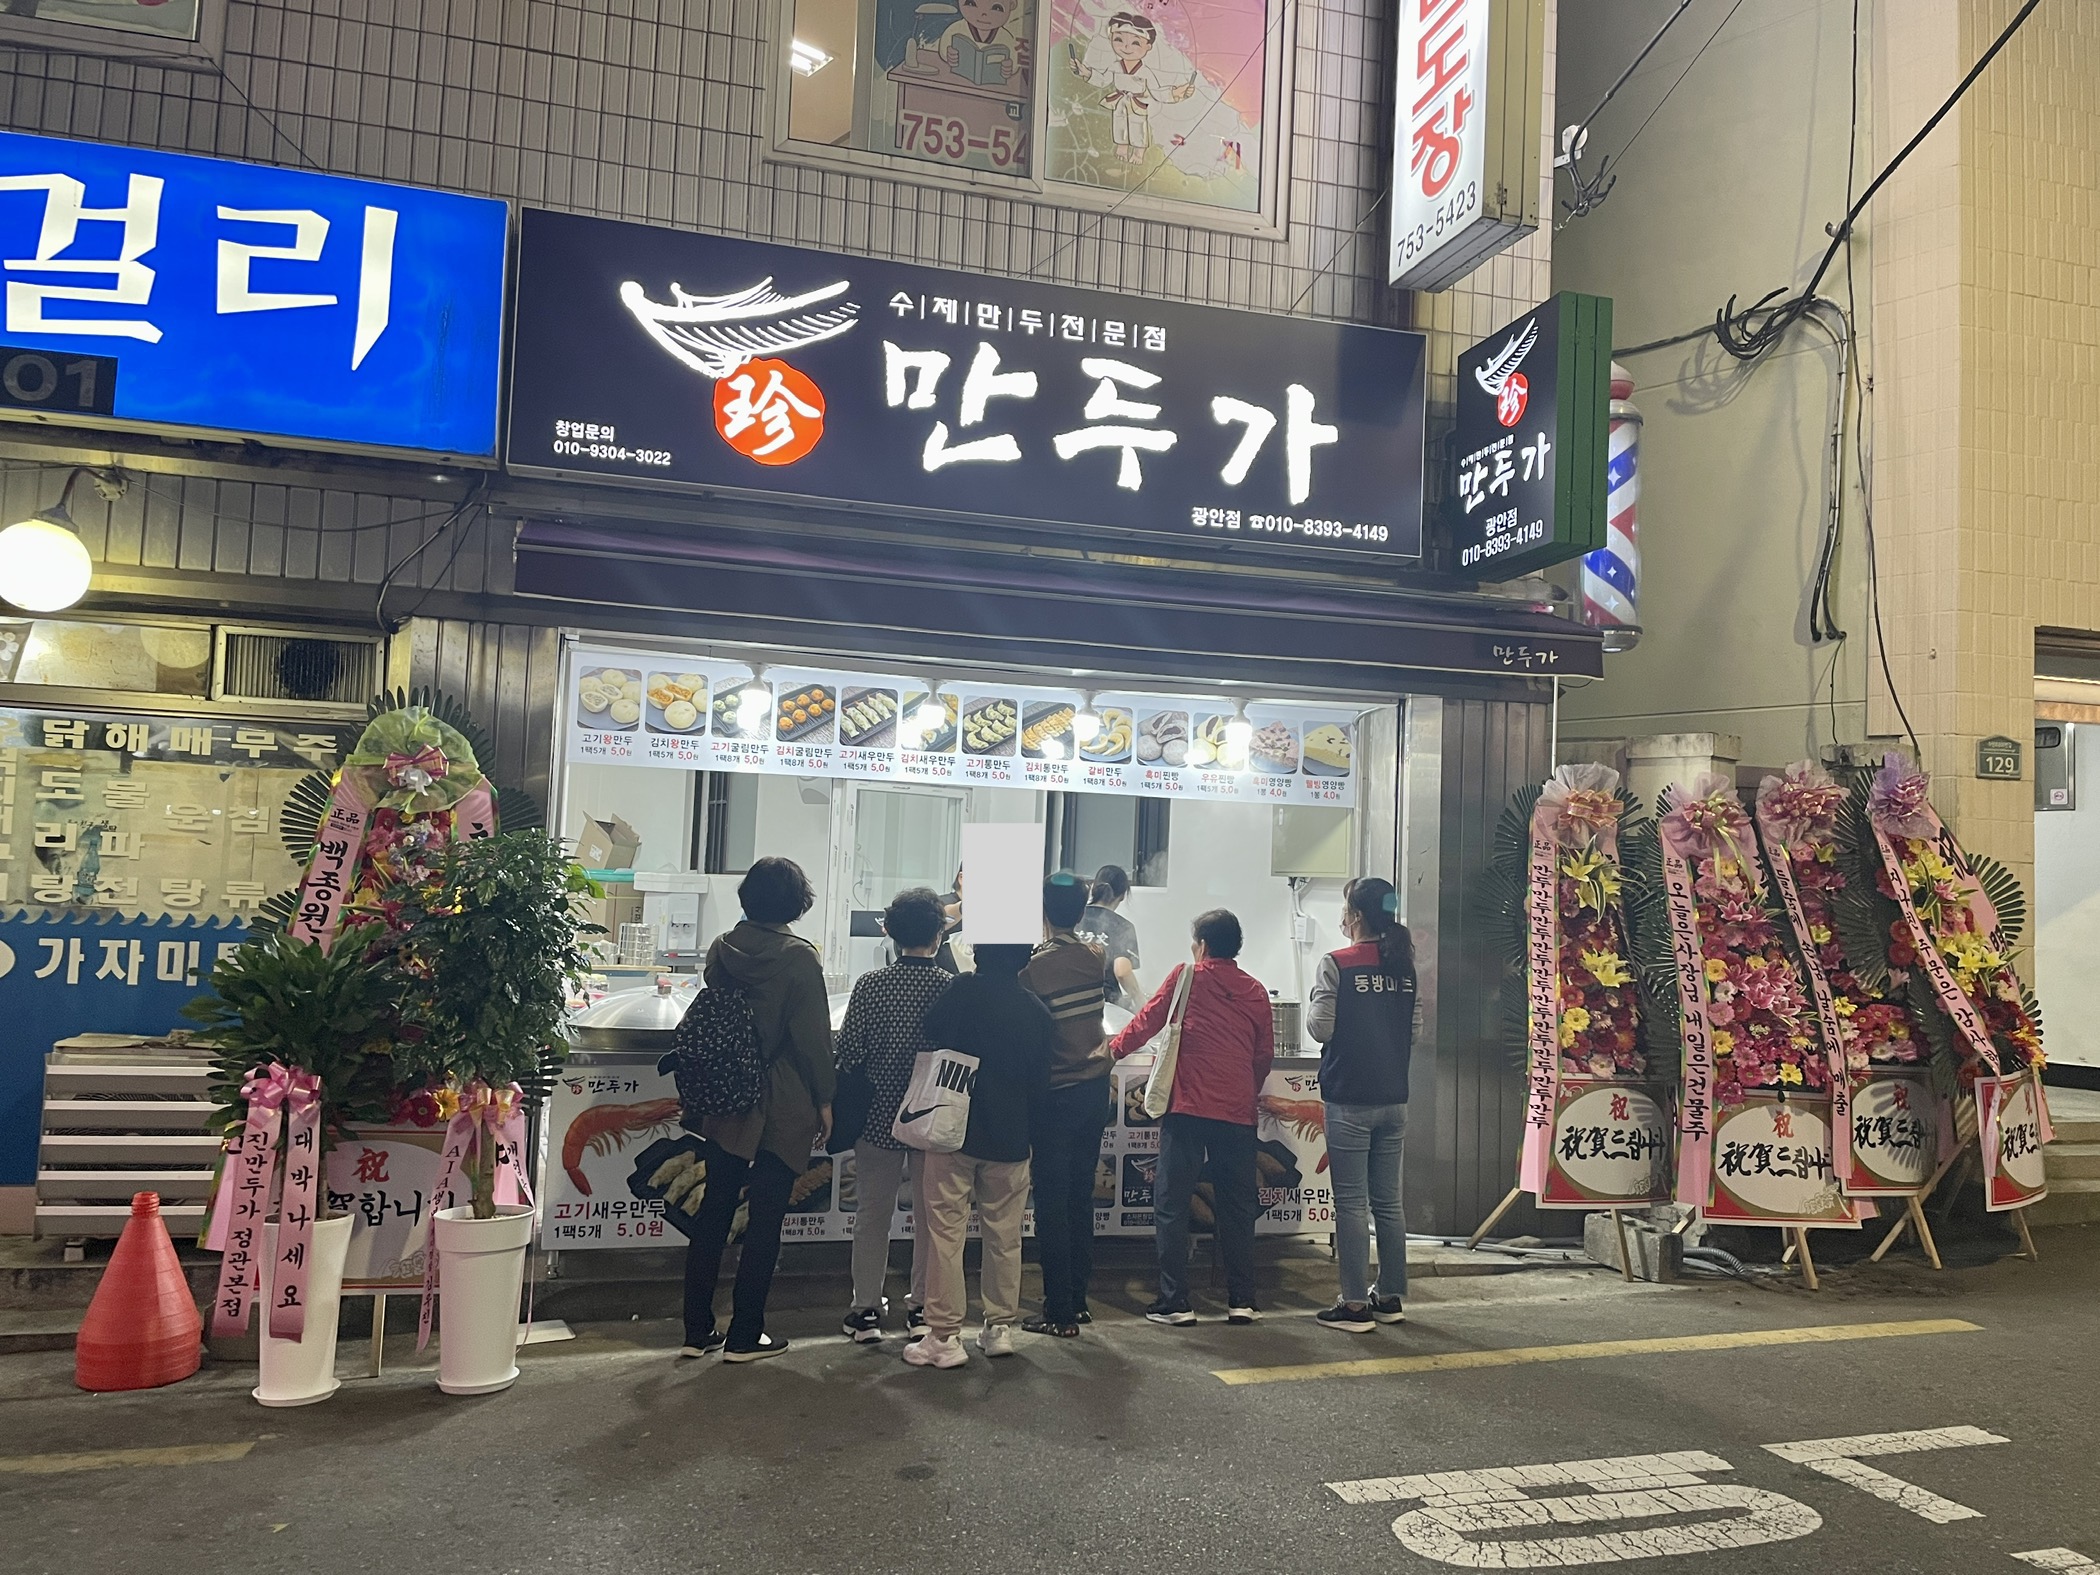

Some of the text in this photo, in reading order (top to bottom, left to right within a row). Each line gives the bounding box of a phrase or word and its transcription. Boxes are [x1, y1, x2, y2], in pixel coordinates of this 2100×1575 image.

[1411, 0, 1472, 198] 도장
[1397, 180, 1477, 268] 753-5423
[0, 173, 398, 370] 걸리
[724, 370, 821, 456] 珍
[882, 340, 1340, 505] 만두가
[554, 420, 615, 442] 창업문의
[553, 441, 672, 466] 010-9304-3022
[1459, 431, 1551, 514] 만두가
[1191, 506, 1390, 542] 광안점 010-8393-4149
[1485, 507, 1518, 537] 광안점
[1462, 519, 1543, 567] 010-8393-4149
[1493, 644, 1559, 668] 만두가
[582, 733, 633, 746] 고기왕만두
[650, 737, 700, 750] 김치왕만두
[710, 742, 770, 754] 고기굴림만두
[776, 745, 833, 758] 김치굴림만두
[839, 750, 895, 762] 고기새우만두
[900, 753, 956, 766] 김치새우만두
[966, 758, 1011, 770] 고기통만두
[1025, 761, 1069, 774] 김치통만두
[1088, 766, 1122, 777] 갈비만두
[1985, 755, 2015, 773] 129
[1201, 773, 1235, 785] 우유찐빵
[935, 1058, 978, 1094] NIK
[588, 1080, 640, 1094] 만두가
[1609, 1093, 1630, 1121] 祝
[1772, 1110, 1795, 1138] 祝
[351, 1147, 390, 1184] 祝
[1259, 1187, 1336, 1206] 김치새우만
[554, 1199, 666, 1220] 고기새우만두
[1266, 1209, 1302, 1222] 1팩5개
[554, 1220, 664, 1239] 1팩5개 5.0원
